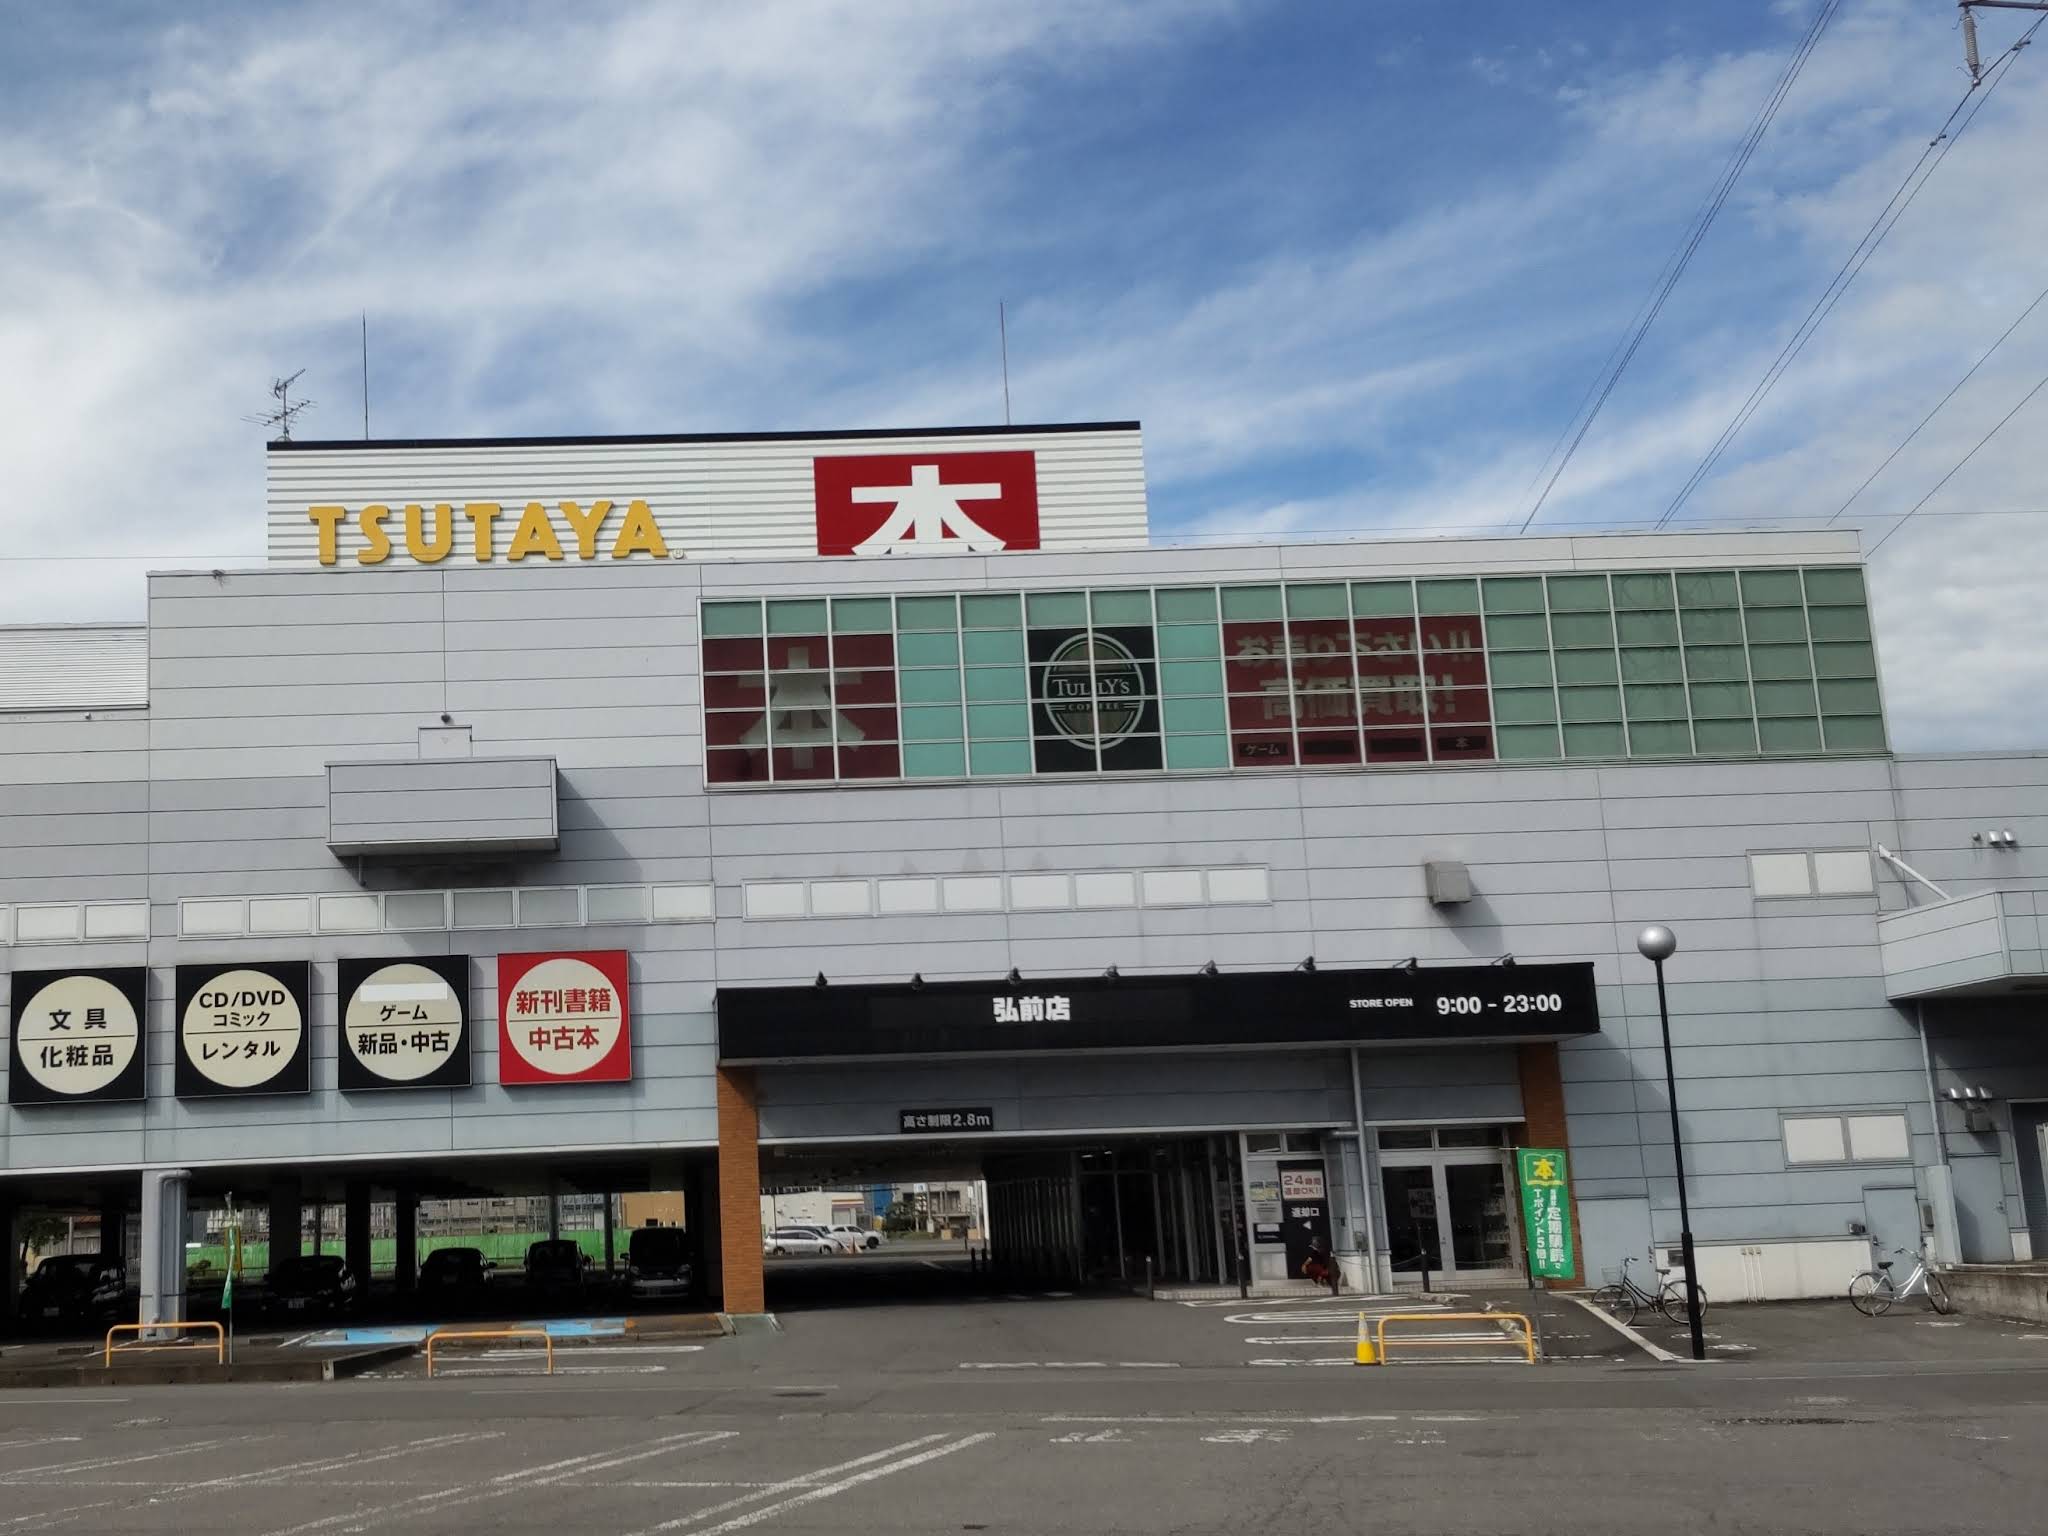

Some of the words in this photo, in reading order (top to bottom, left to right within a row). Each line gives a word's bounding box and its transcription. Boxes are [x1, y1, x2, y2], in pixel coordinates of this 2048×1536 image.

[850, 464, 1007, 555] 本
[308, 500, 669, 565] TSUTAYA
[1245, 744, 1281, 756] ゲーム
[1455, 737, 1471, 749] 本
[199, 989, 286, 1008] CD/DVD
[516, 987, 611, 1015] 新刊書籍
[992, 995, 1071, 1022] 弘前店
[1350, 999, 1384, 1008] STORE
[1384, 998, 1414, 1007] OPEN
[1436, 996, 1482, 1015] 9:00
[1503, 993, 1562, 1013] 23:00
[48, 1008, 107, 1031] 文具
[213, 1011, 271, 1027] コミック
[380, 1004, 428, 1022] ゲーム
[358, 1030, 450, 1055] 新品・中古
[529, 1025, 600, 1051] 中古本
[40, 1044, 114, 1068] 化粧品
[203, 1041, 281, 1060] レンタル
[903, 1113, 991, 1128] 高さ制限2.8m
[1533, 1158, 1556, 1180] 本
